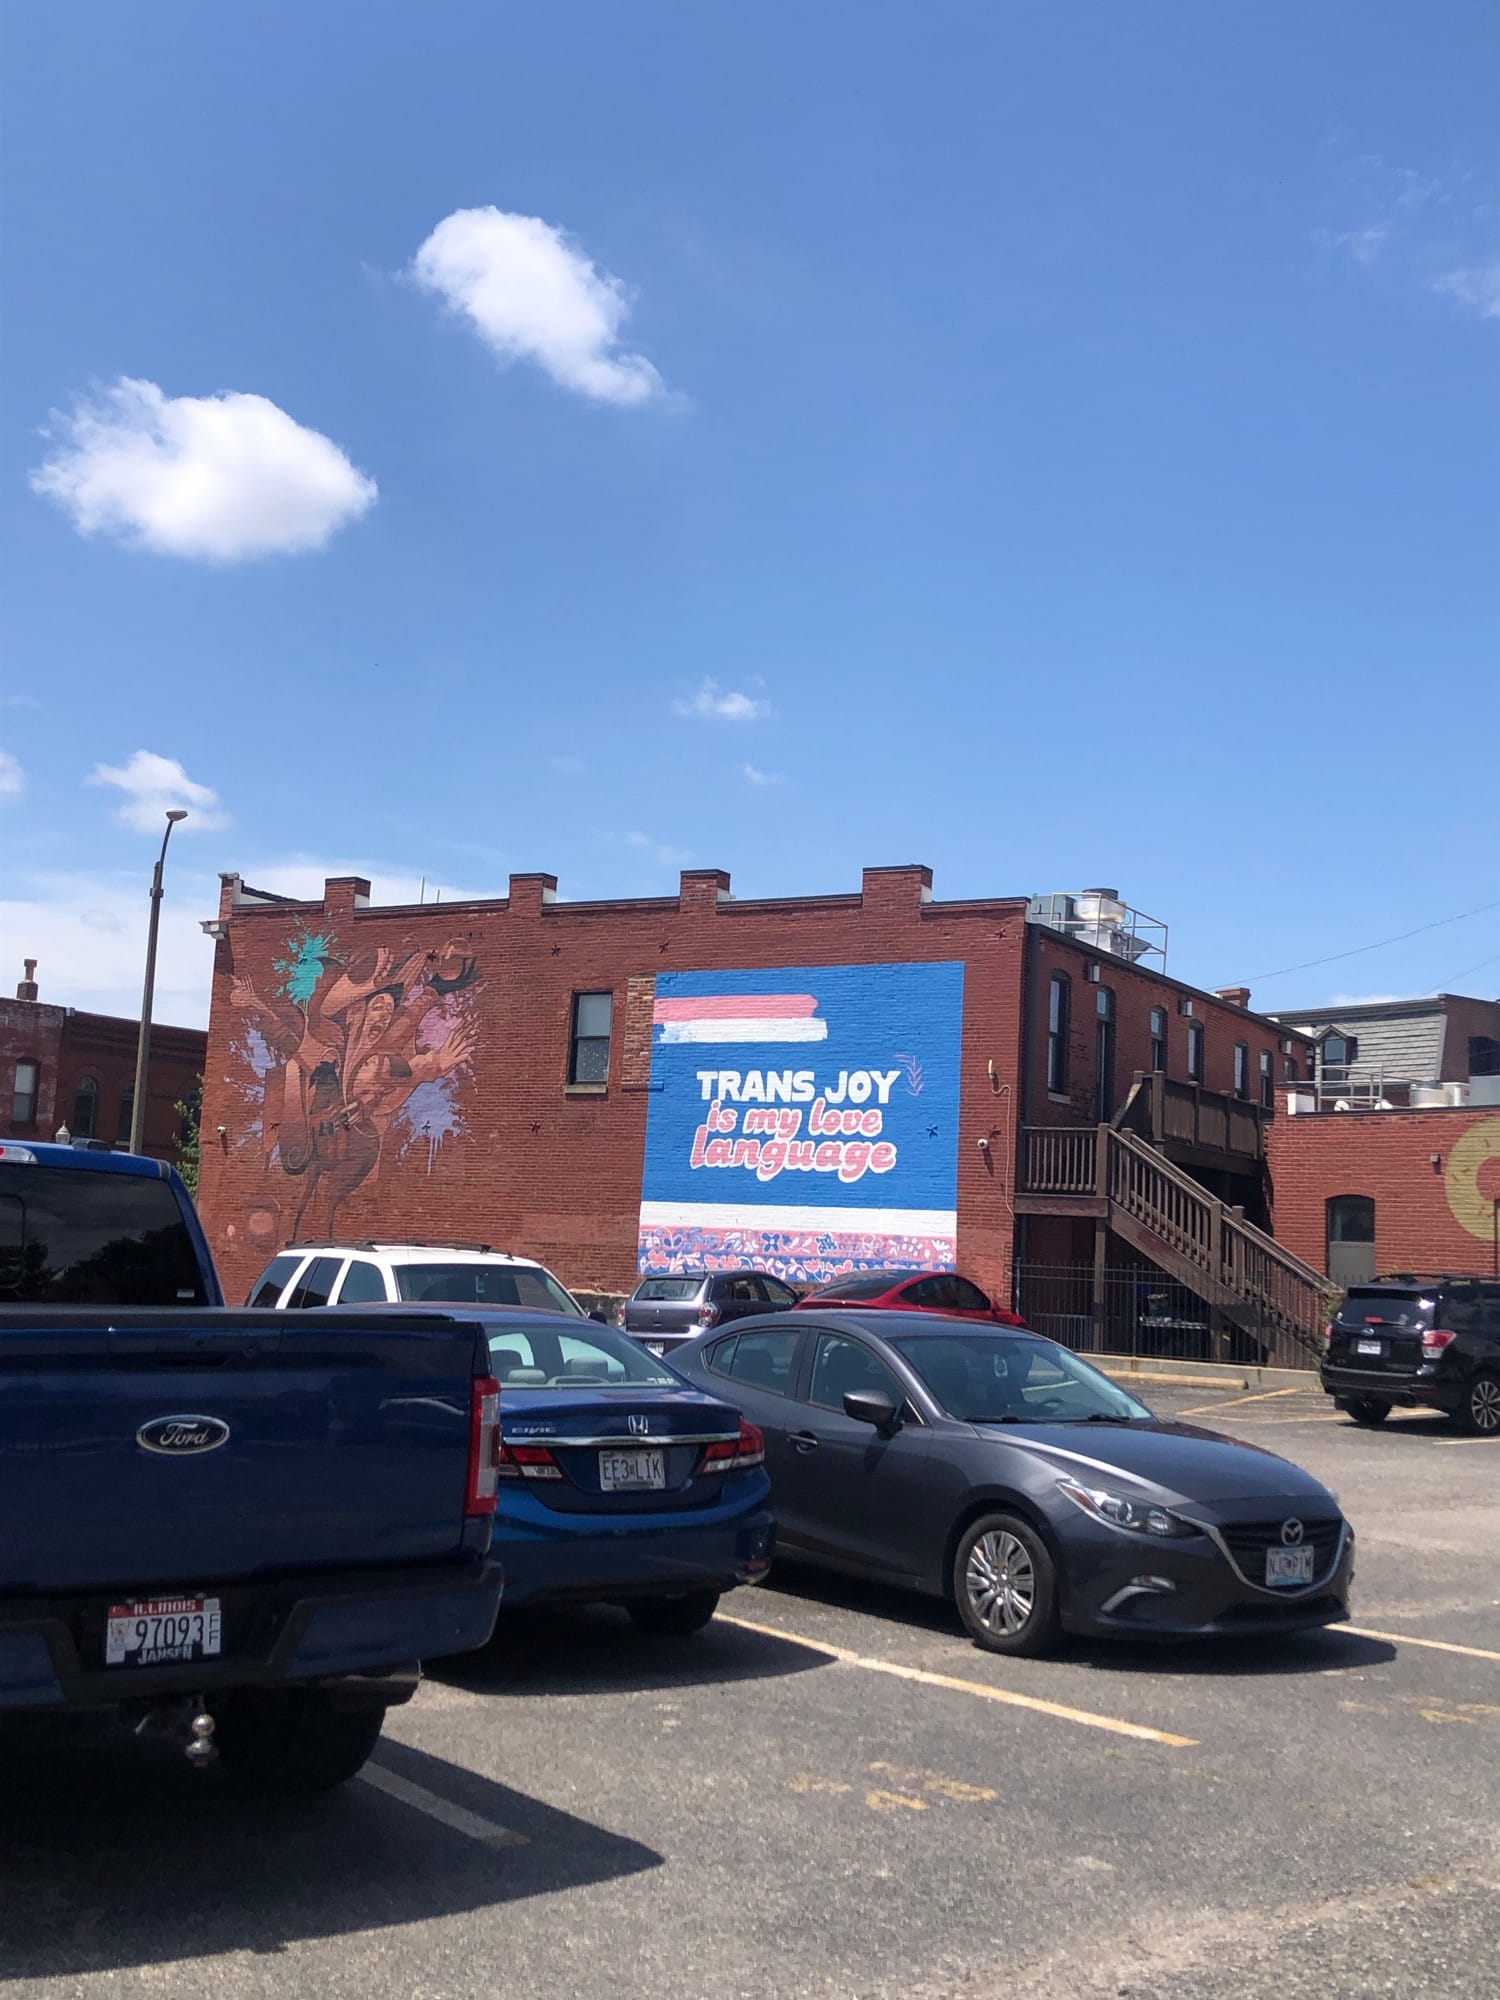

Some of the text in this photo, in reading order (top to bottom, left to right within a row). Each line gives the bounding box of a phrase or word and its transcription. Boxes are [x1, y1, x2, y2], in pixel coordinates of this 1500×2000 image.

[697, 1070, 901, 1103] TRANS JOY
[707, 1097, 883, 1141] is my love
[690, 1124, 897, 1183] language
[159, 1423, 209, 1446] Ford
[135, 1615, 204, 1651] 97093
